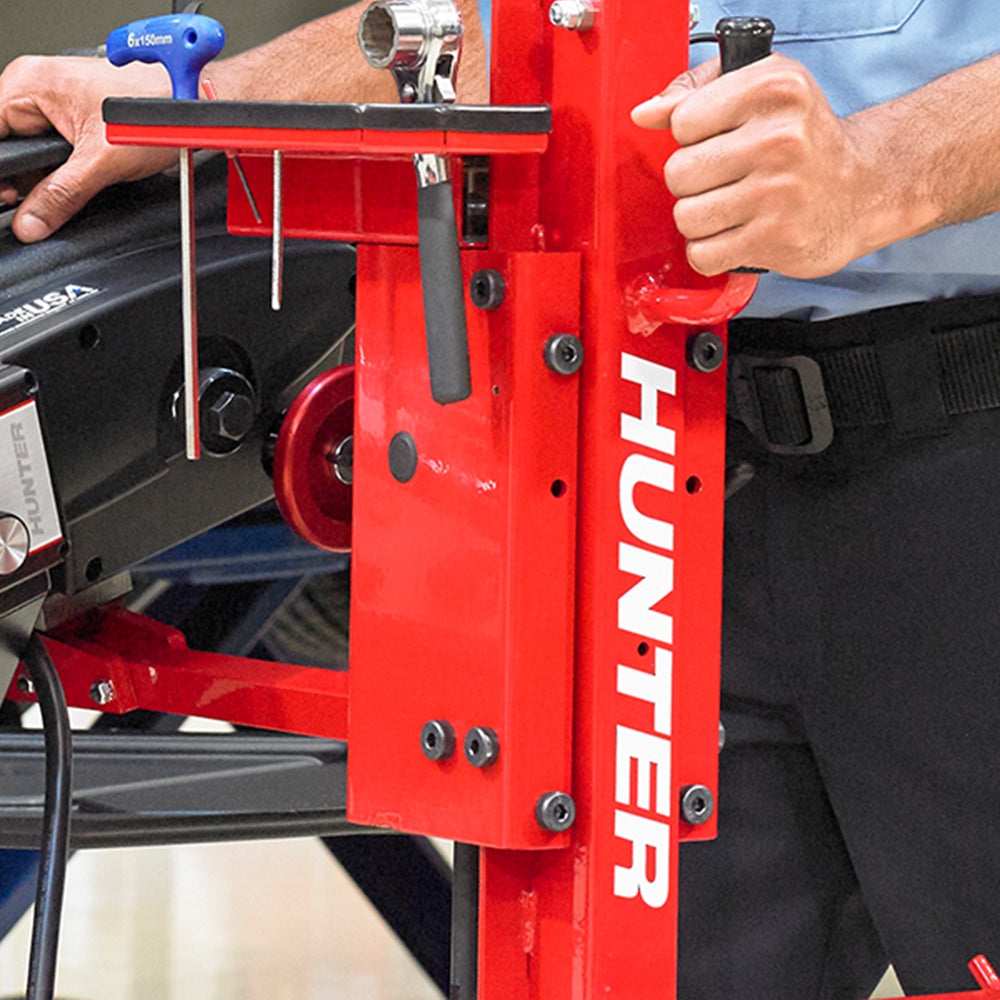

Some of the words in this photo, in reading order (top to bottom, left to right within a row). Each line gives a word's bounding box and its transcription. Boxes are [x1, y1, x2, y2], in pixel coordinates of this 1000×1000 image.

[127, 32, 173, 48] 6x150mm
[22, 284, 95, 316] USA
[10, 421, 45, 536] HUNTER
[614, 351, 677, 909] HUNTER
